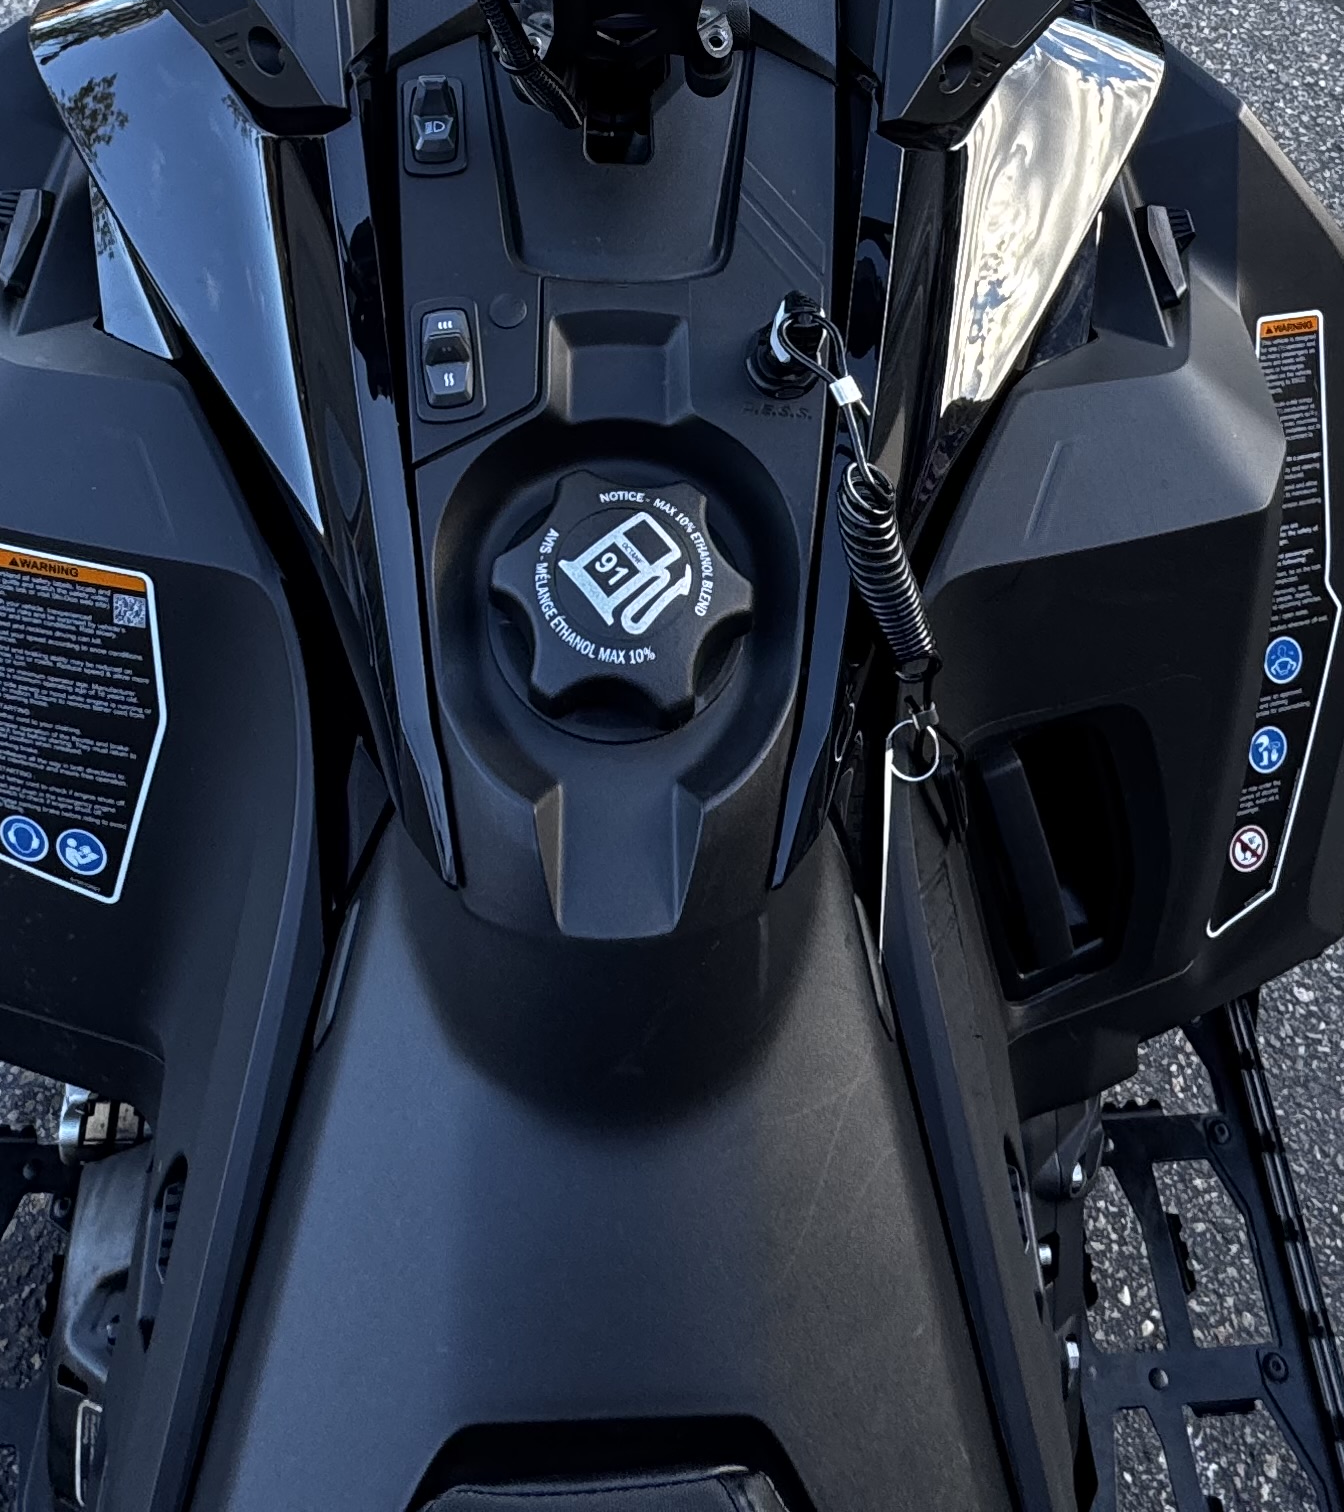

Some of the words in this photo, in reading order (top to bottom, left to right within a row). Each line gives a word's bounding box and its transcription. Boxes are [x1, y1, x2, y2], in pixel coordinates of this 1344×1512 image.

[599, 490, 645, 503] NOTICE
[653, 498, 678, 516] MAX
[675, 512, 697, 533] 10%
[539, 527, 560, 555] AVIS
[18, 556, 79, 578] WARNING
[690, 531, 714, 578] ETHANOL
[595, 552, 629, 586] 91
[535, 562, 558, 620] MÉLANGE
[694, 579, 714, 617] BLEND
[549, 615, 596, 659] ÉTHANOL
[597, 647, 626, 665] MAX
[628, 645, 656, 665] 10%
